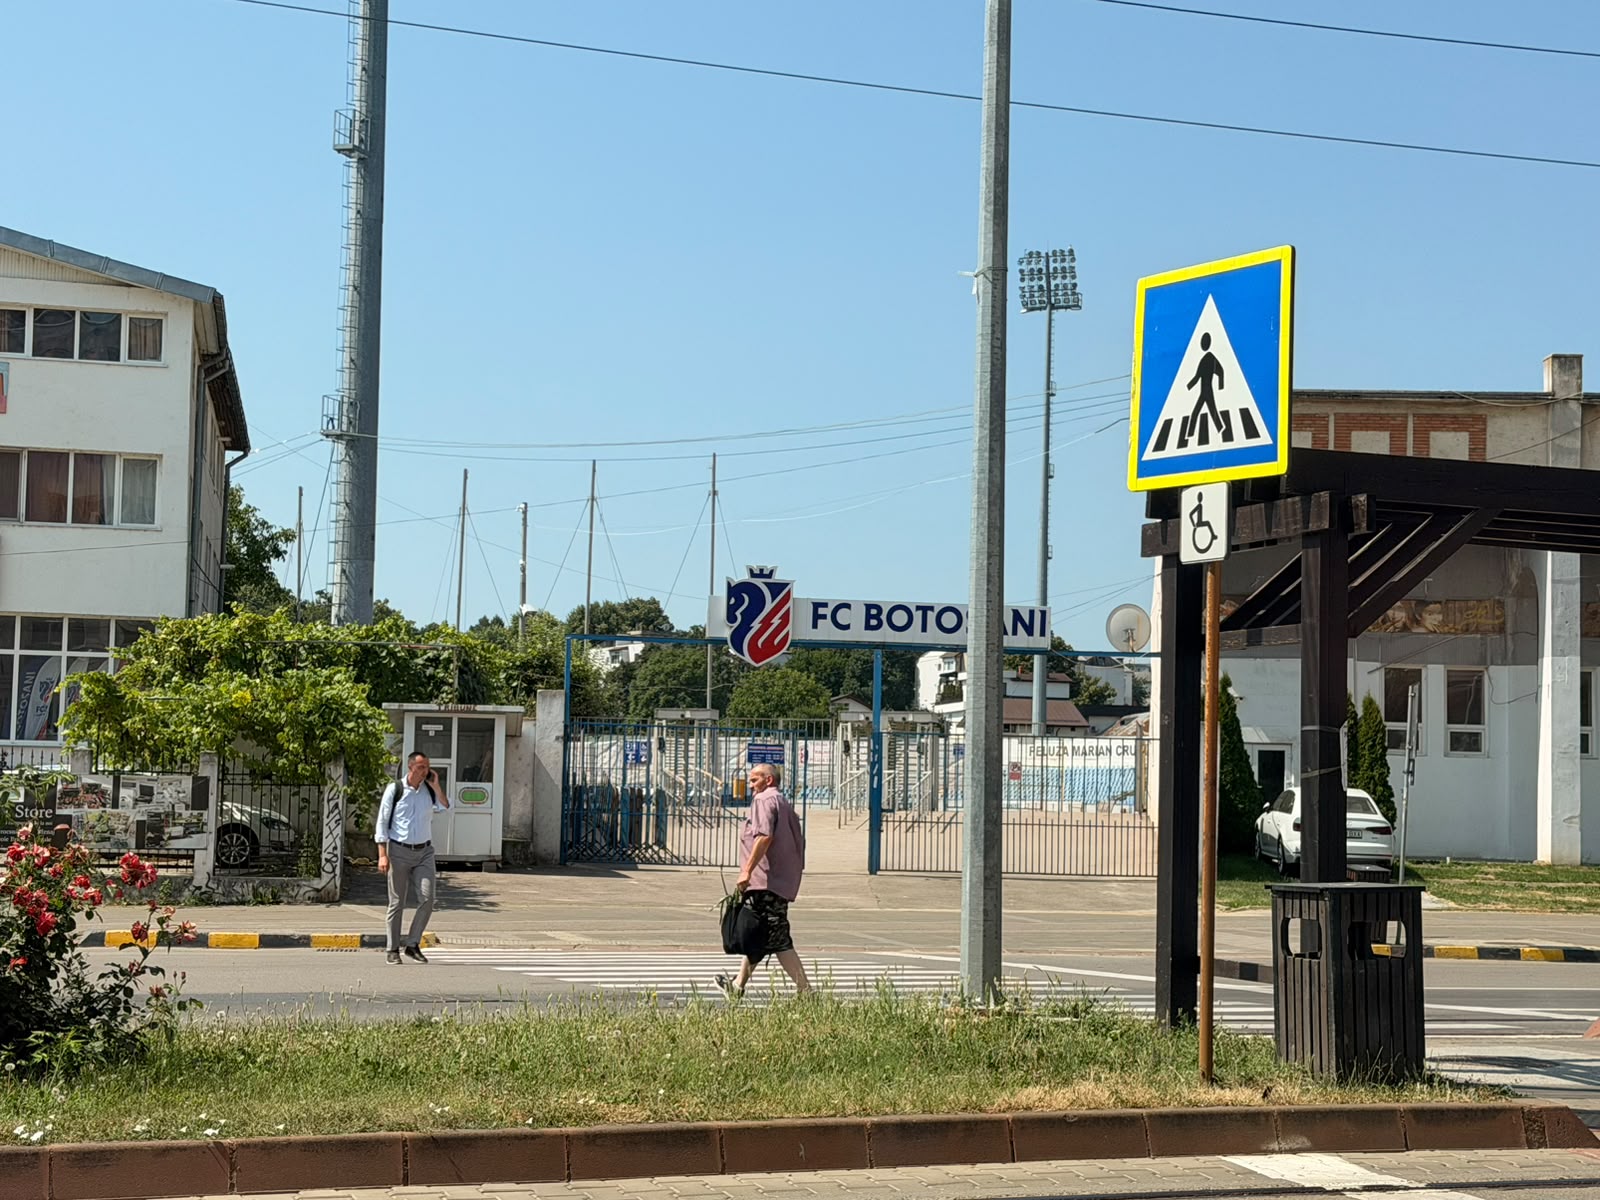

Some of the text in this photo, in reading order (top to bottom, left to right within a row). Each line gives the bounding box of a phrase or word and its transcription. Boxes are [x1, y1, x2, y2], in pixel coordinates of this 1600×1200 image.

[811, 601, 1047, 637] FC BOTONI
[1072, 744, 1112, 757] MARIAN
[15, 804, 53, 818] Store
